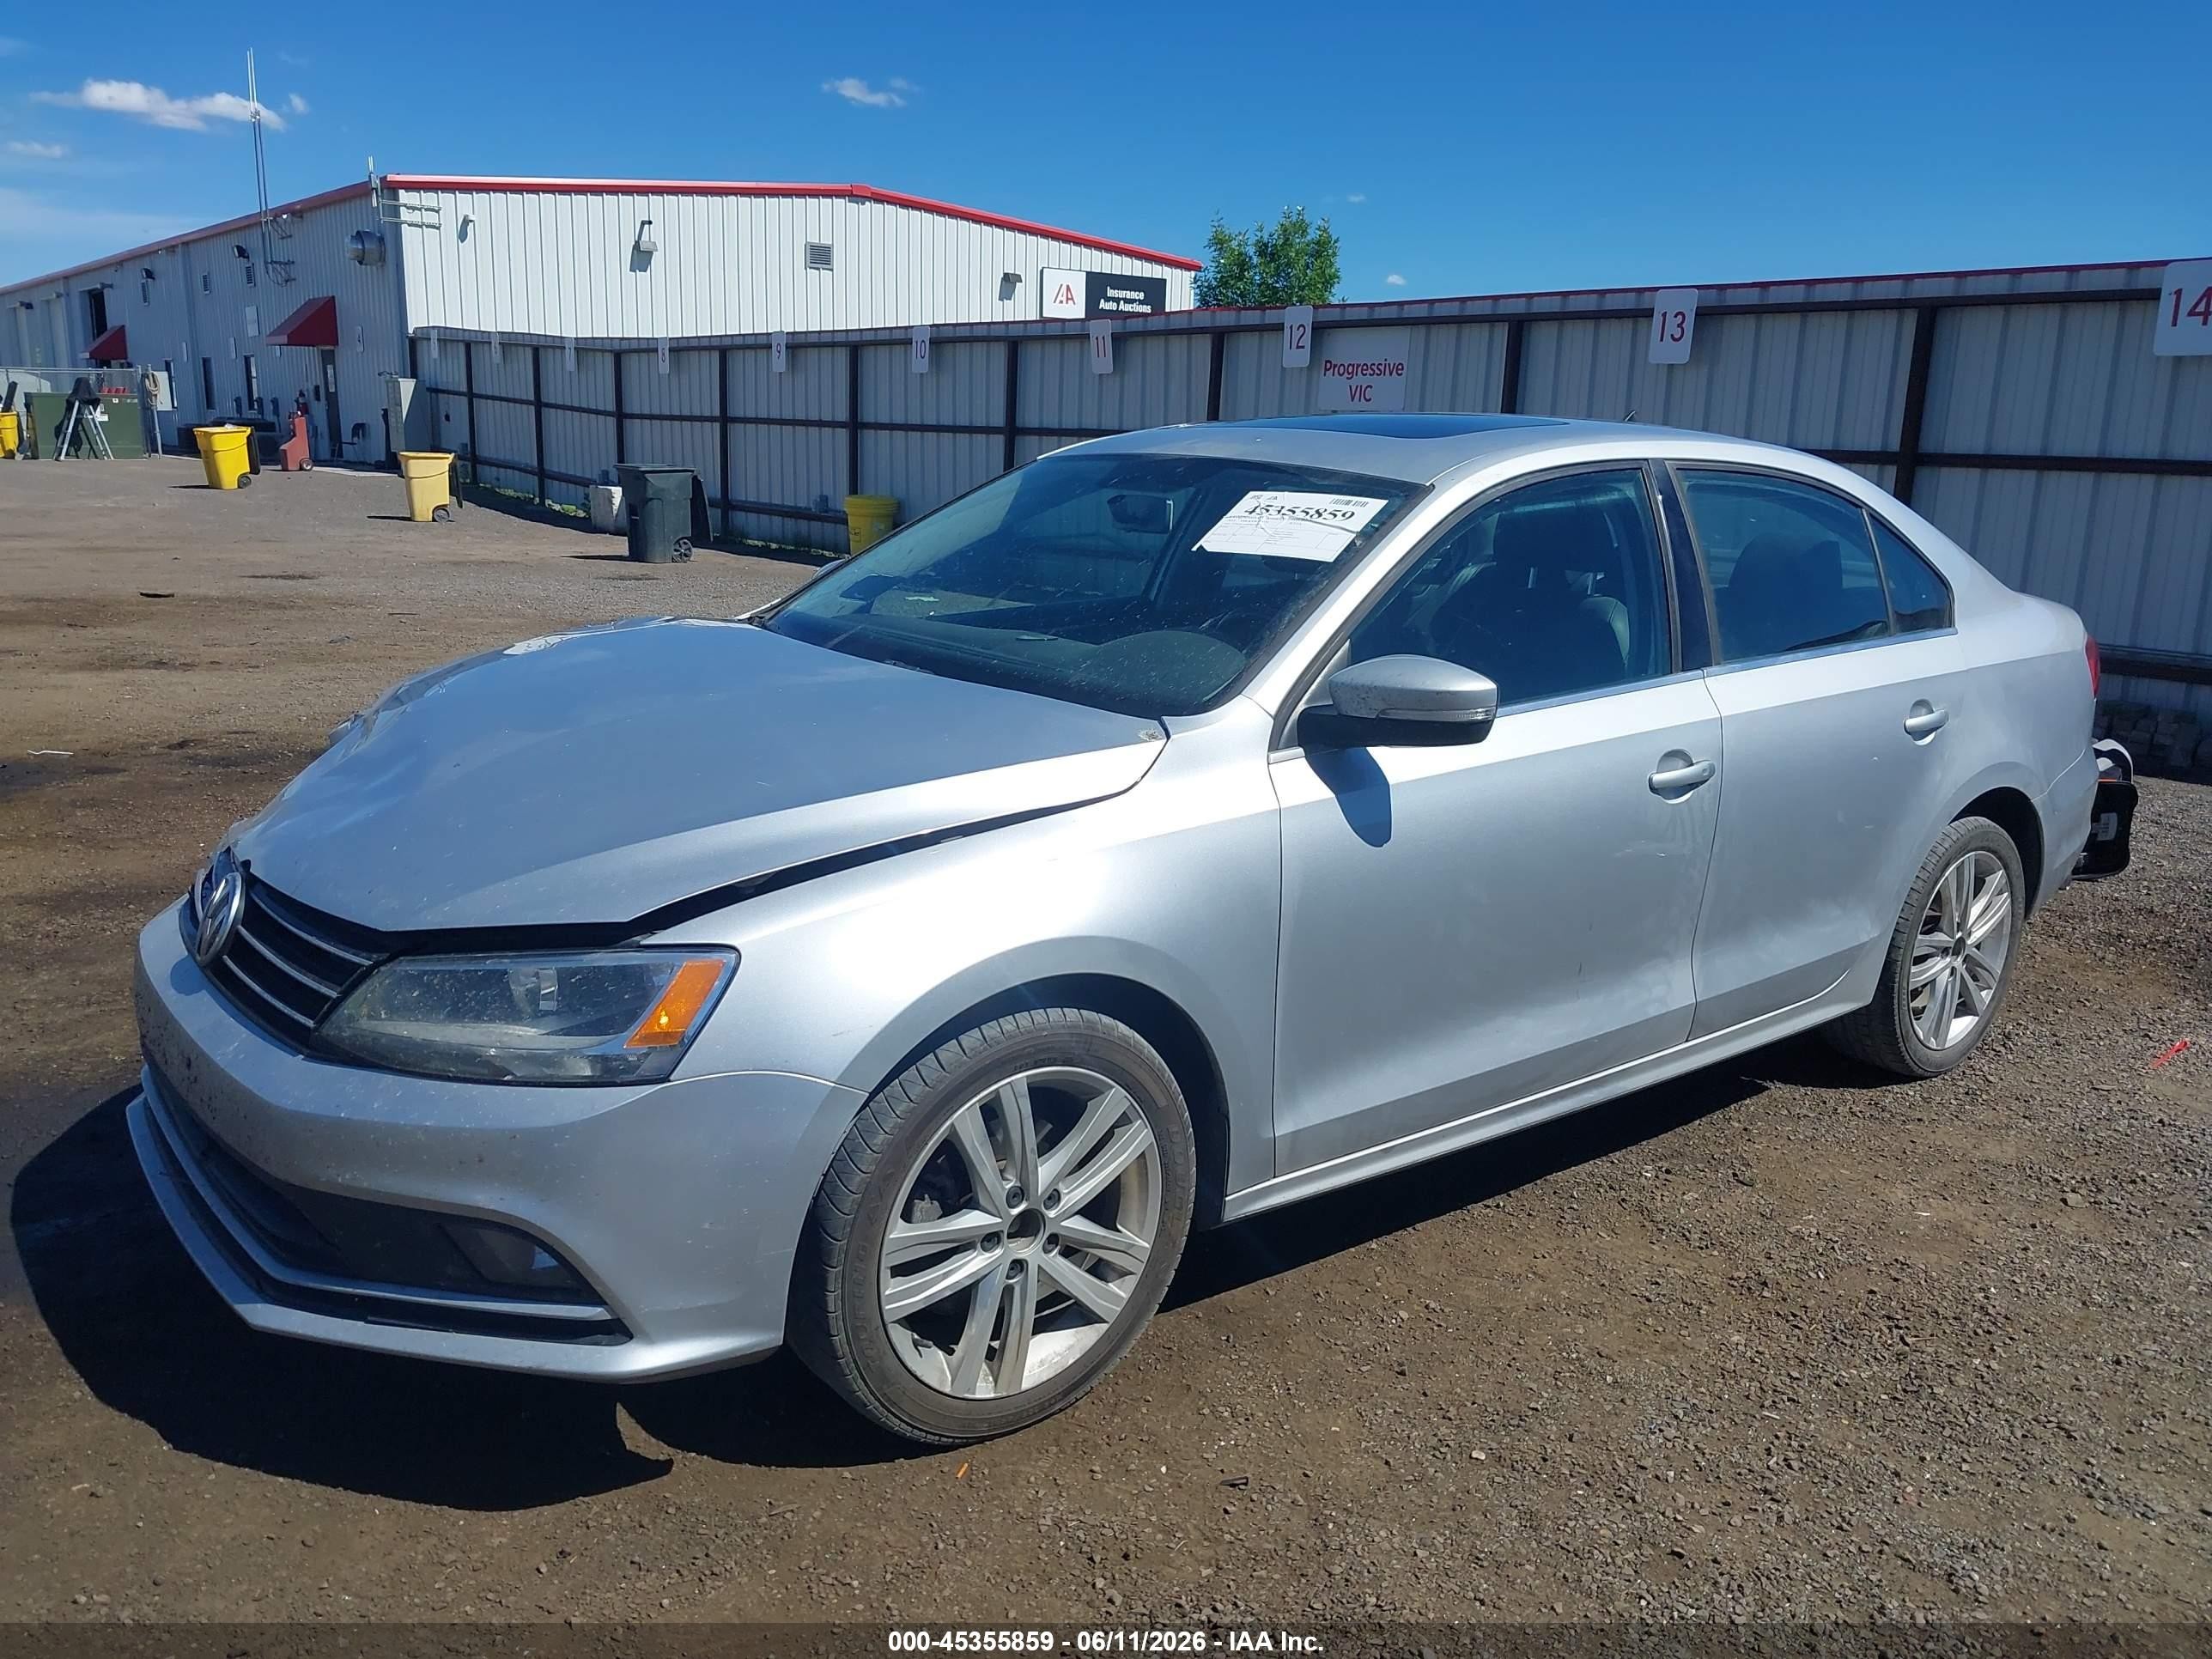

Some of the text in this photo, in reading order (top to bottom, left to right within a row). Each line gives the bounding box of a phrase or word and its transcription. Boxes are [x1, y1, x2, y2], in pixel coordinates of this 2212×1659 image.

[1106, 286, 1145, 300] Insurance
[1098, 298, 1152, 313] Auto Auctions
[2170, 286, 2212, 327] 14
[1288, 323, 1306, 350] 12
[1659, 311, 1686, 343] 13
[775, 343, 781, 360] 9
[915, 339, 927, 360] 10
[1095, 336, 1107, 358] 11
[1323, 358, 1405, 380] Progressive
[1349, 385, 1373, 403] VIC
[1244, 504, 1355, 522] 45355859
